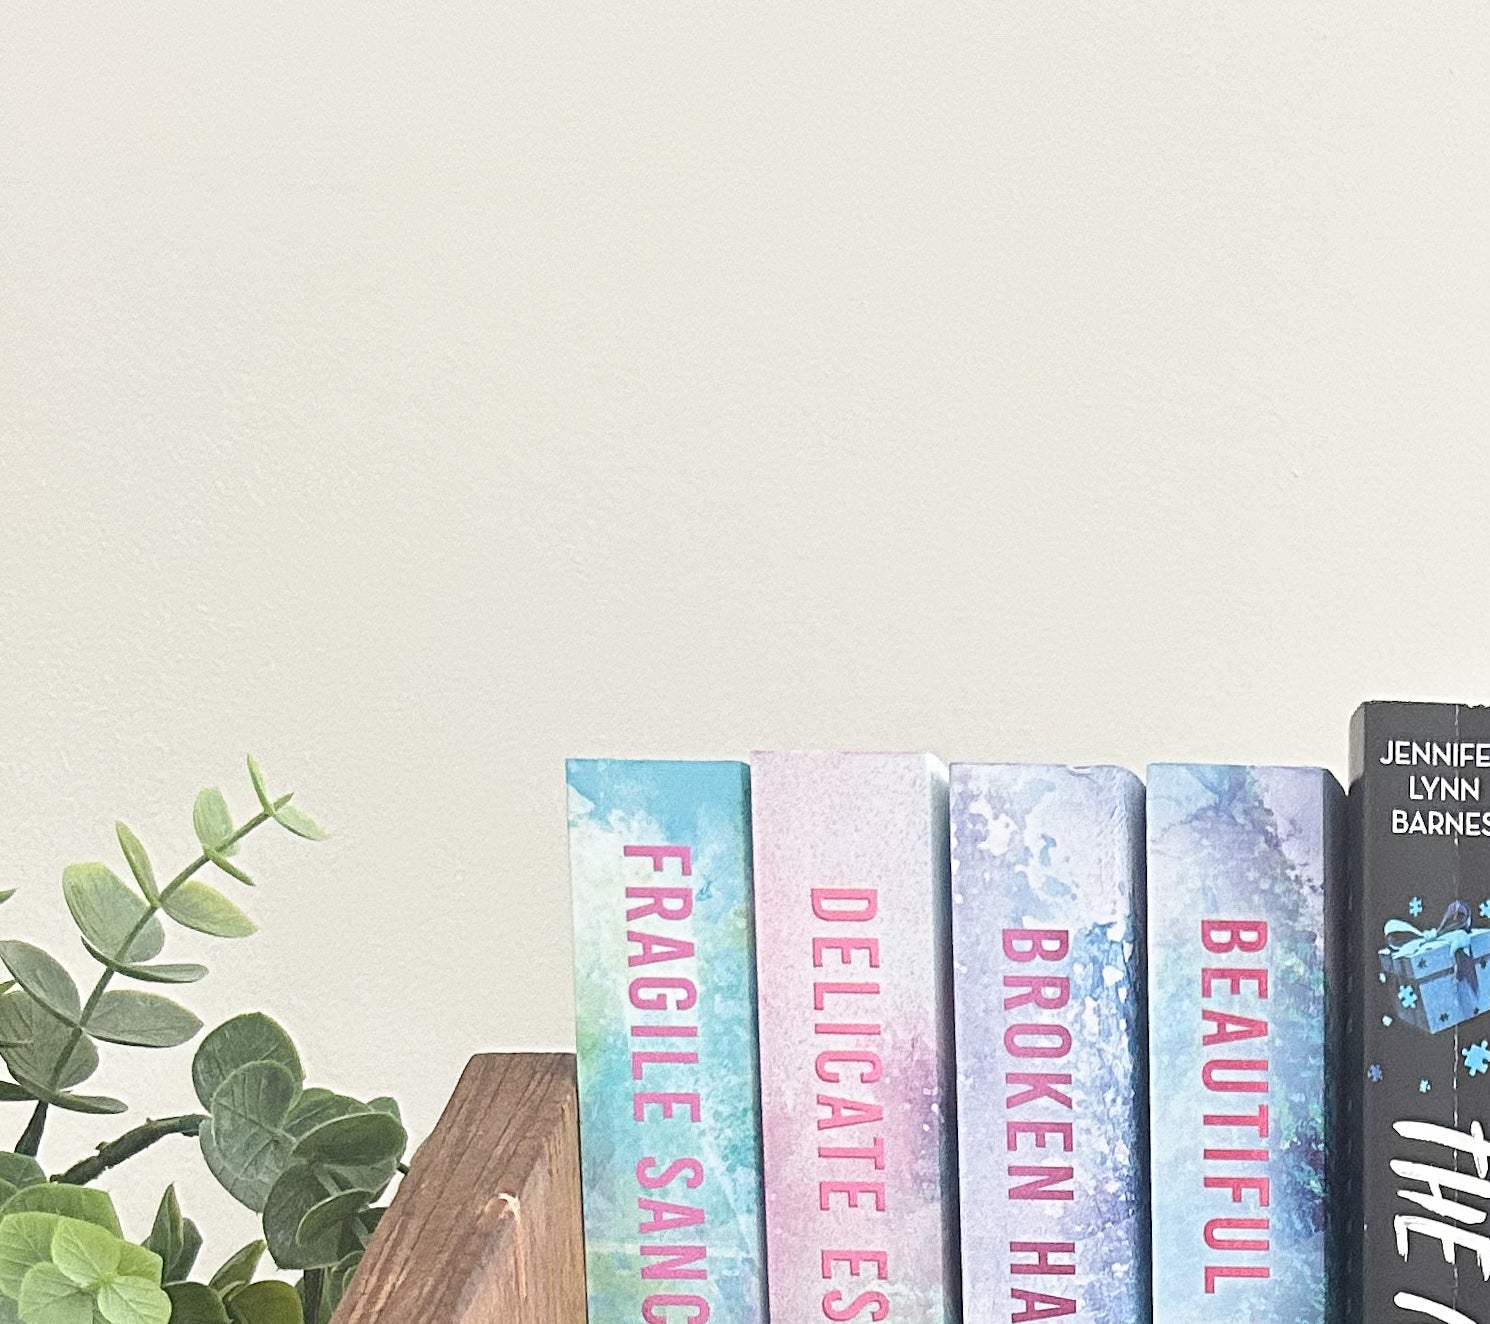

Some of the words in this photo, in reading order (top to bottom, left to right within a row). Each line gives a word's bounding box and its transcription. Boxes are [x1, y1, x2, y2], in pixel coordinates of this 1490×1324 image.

[1409, 775, 1480, 801] LYNN
[623, 844, 702, 1123] FRAGILE
[810, 888, 886, 1212] DELICATE
[1002, 929, 1074, 1201] BROKEN
[1201, 920, 1270, 1294] BEAUTIFUL
